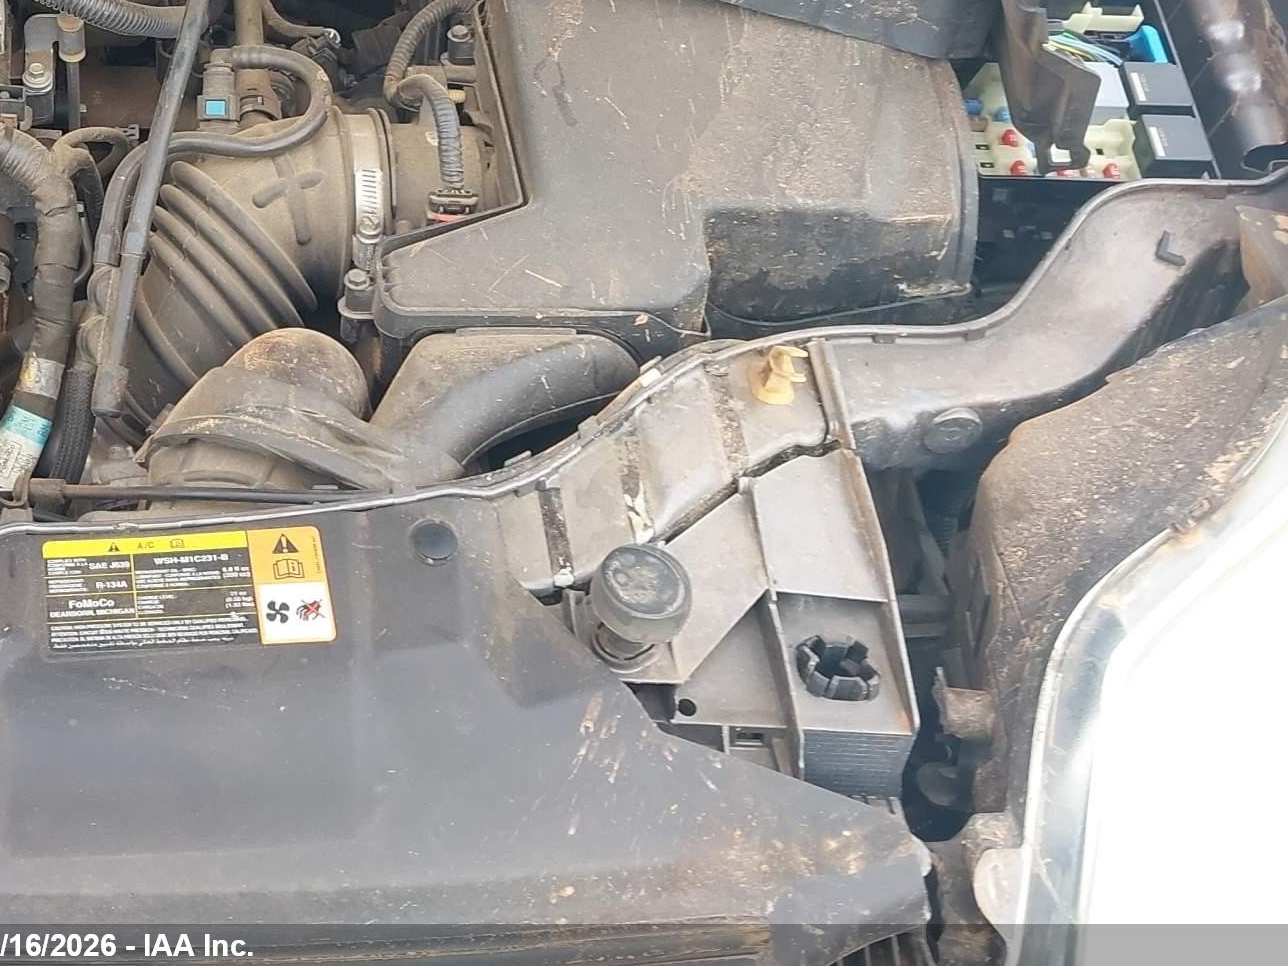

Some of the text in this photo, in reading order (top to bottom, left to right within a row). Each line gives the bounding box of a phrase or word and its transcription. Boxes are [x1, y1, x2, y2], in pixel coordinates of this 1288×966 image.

[137, 540, 155, 550] A/C
[88, 561, 108, 570] SAE
[95, 580, 129, 590] R-134A
[68, 598, 116, 610] FoMoCo
